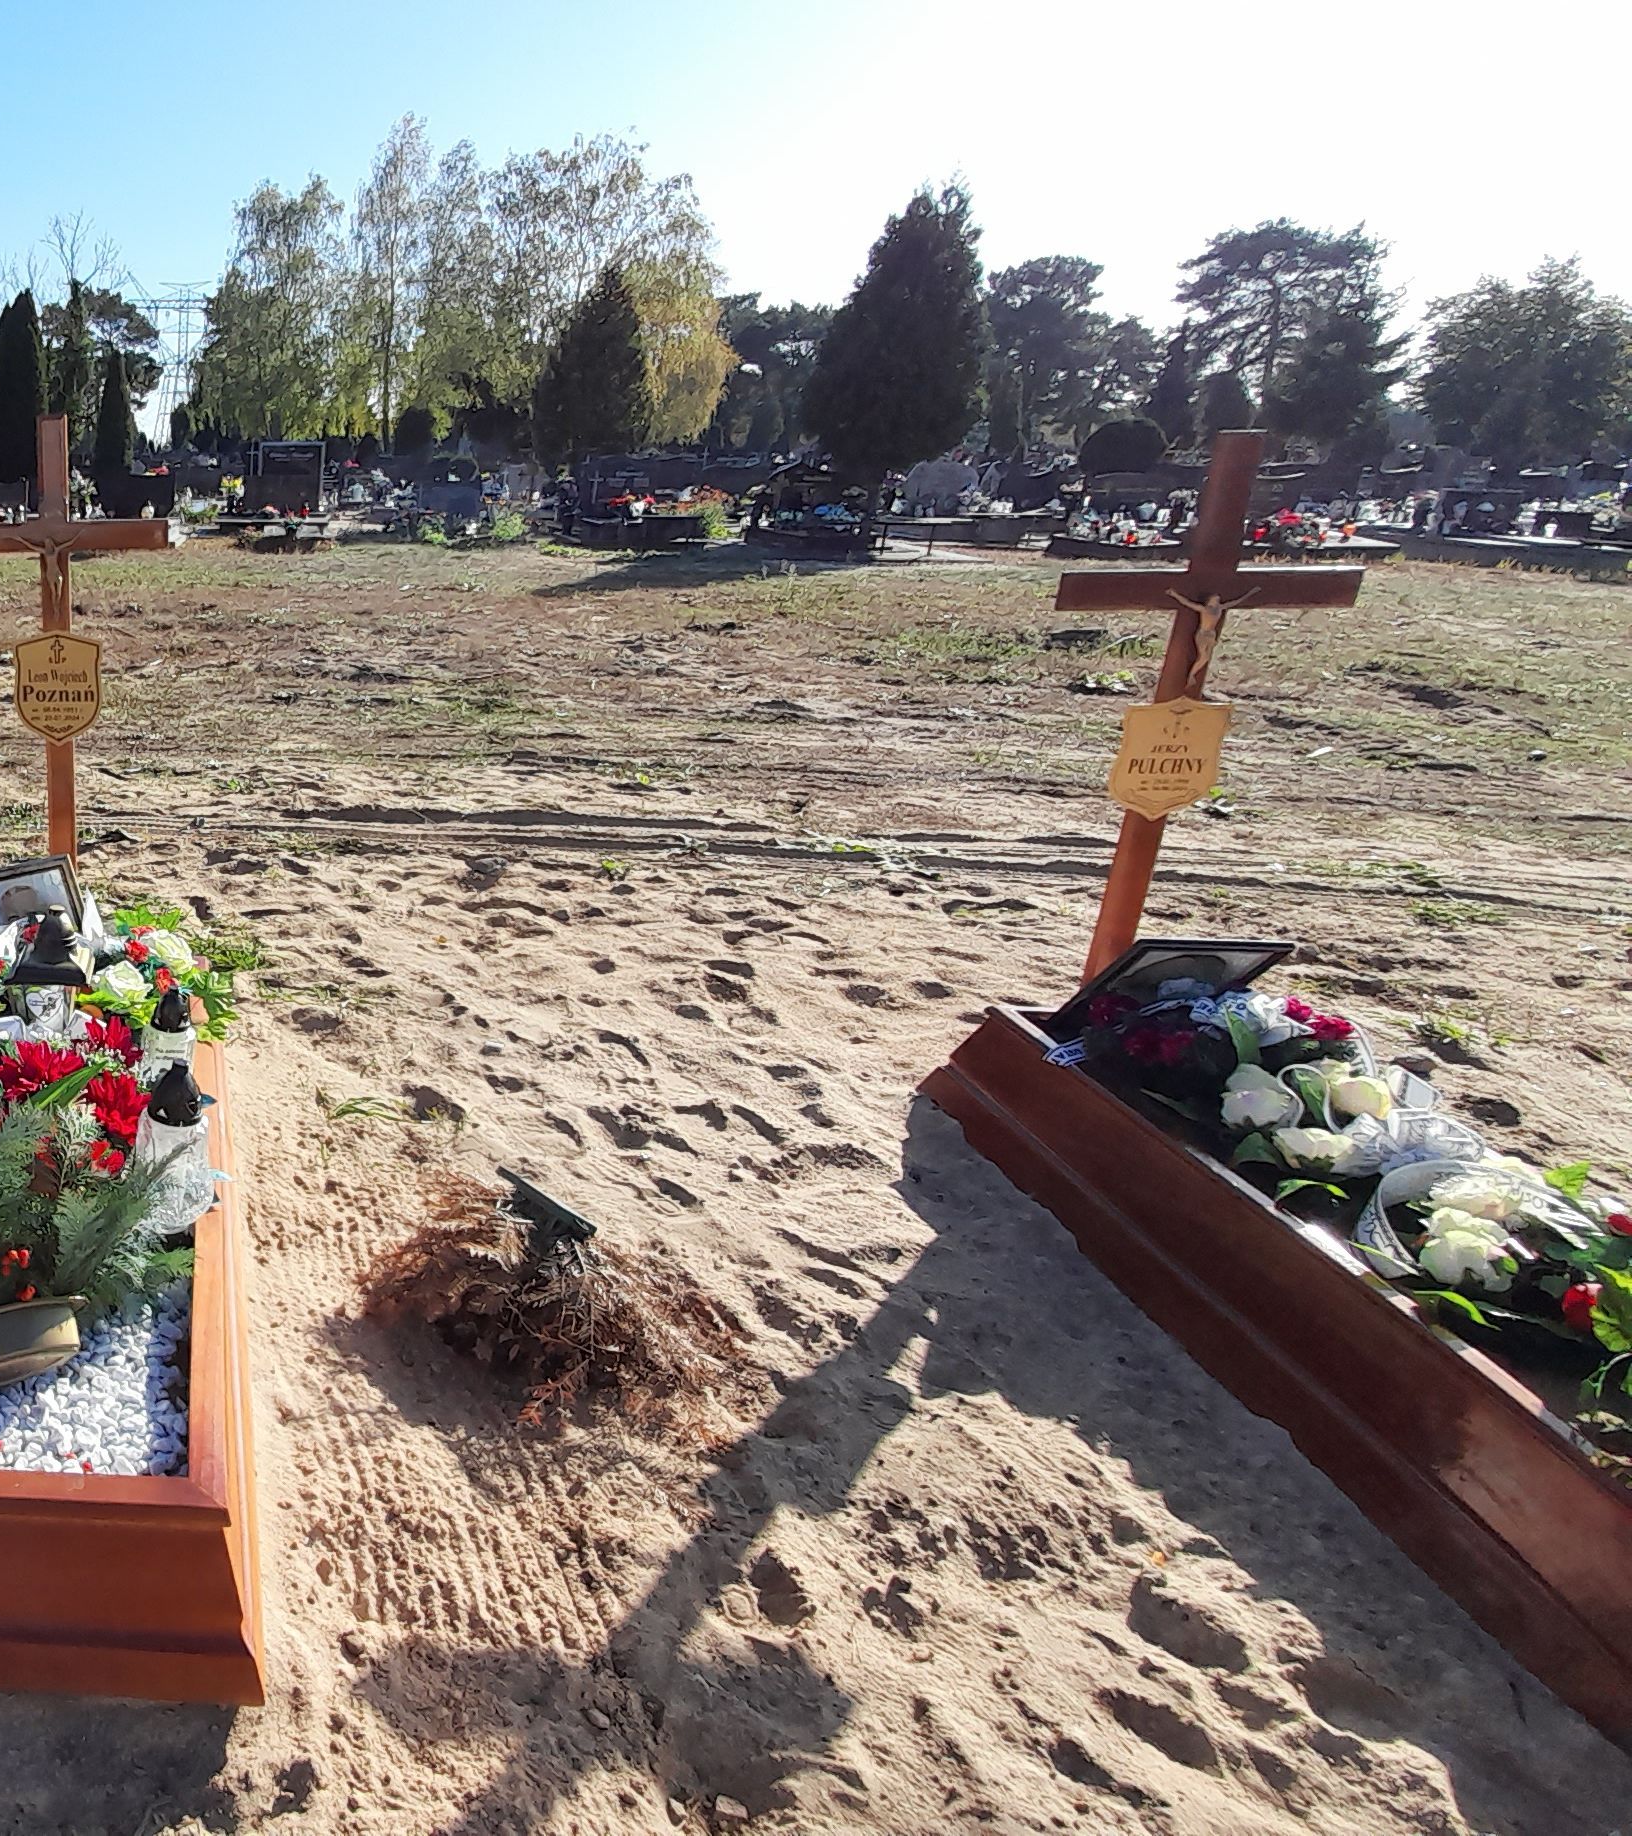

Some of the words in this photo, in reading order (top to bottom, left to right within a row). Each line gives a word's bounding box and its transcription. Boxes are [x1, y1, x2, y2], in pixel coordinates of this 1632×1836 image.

[22, 684, 95, 703] Poznań
[1150, 744, 1189, 753] JERZY
[1127, 758, 1206, 775] PULCHNY
